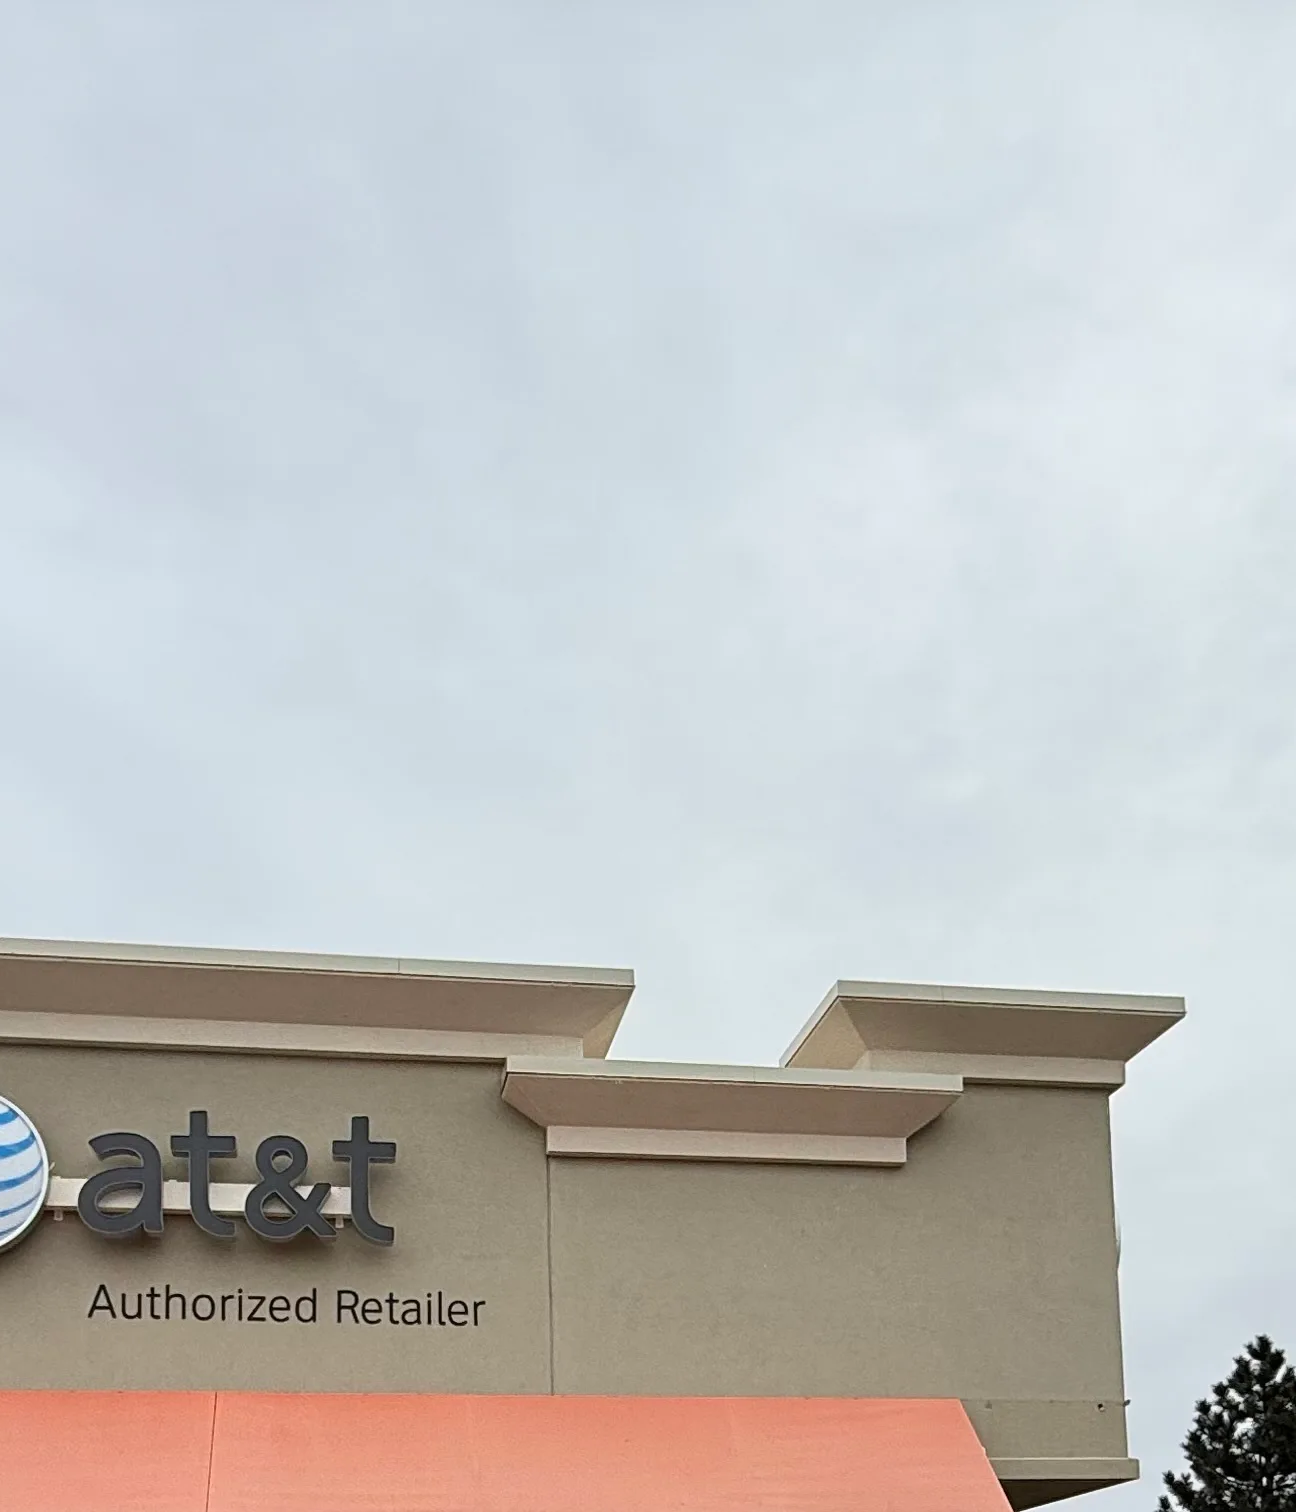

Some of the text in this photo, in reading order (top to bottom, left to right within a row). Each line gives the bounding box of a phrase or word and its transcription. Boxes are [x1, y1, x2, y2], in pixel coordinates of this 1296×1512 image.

[78, 1110, 397, 1247] at&t
[87, 1284, 486, 1327] Authorized Retailer
